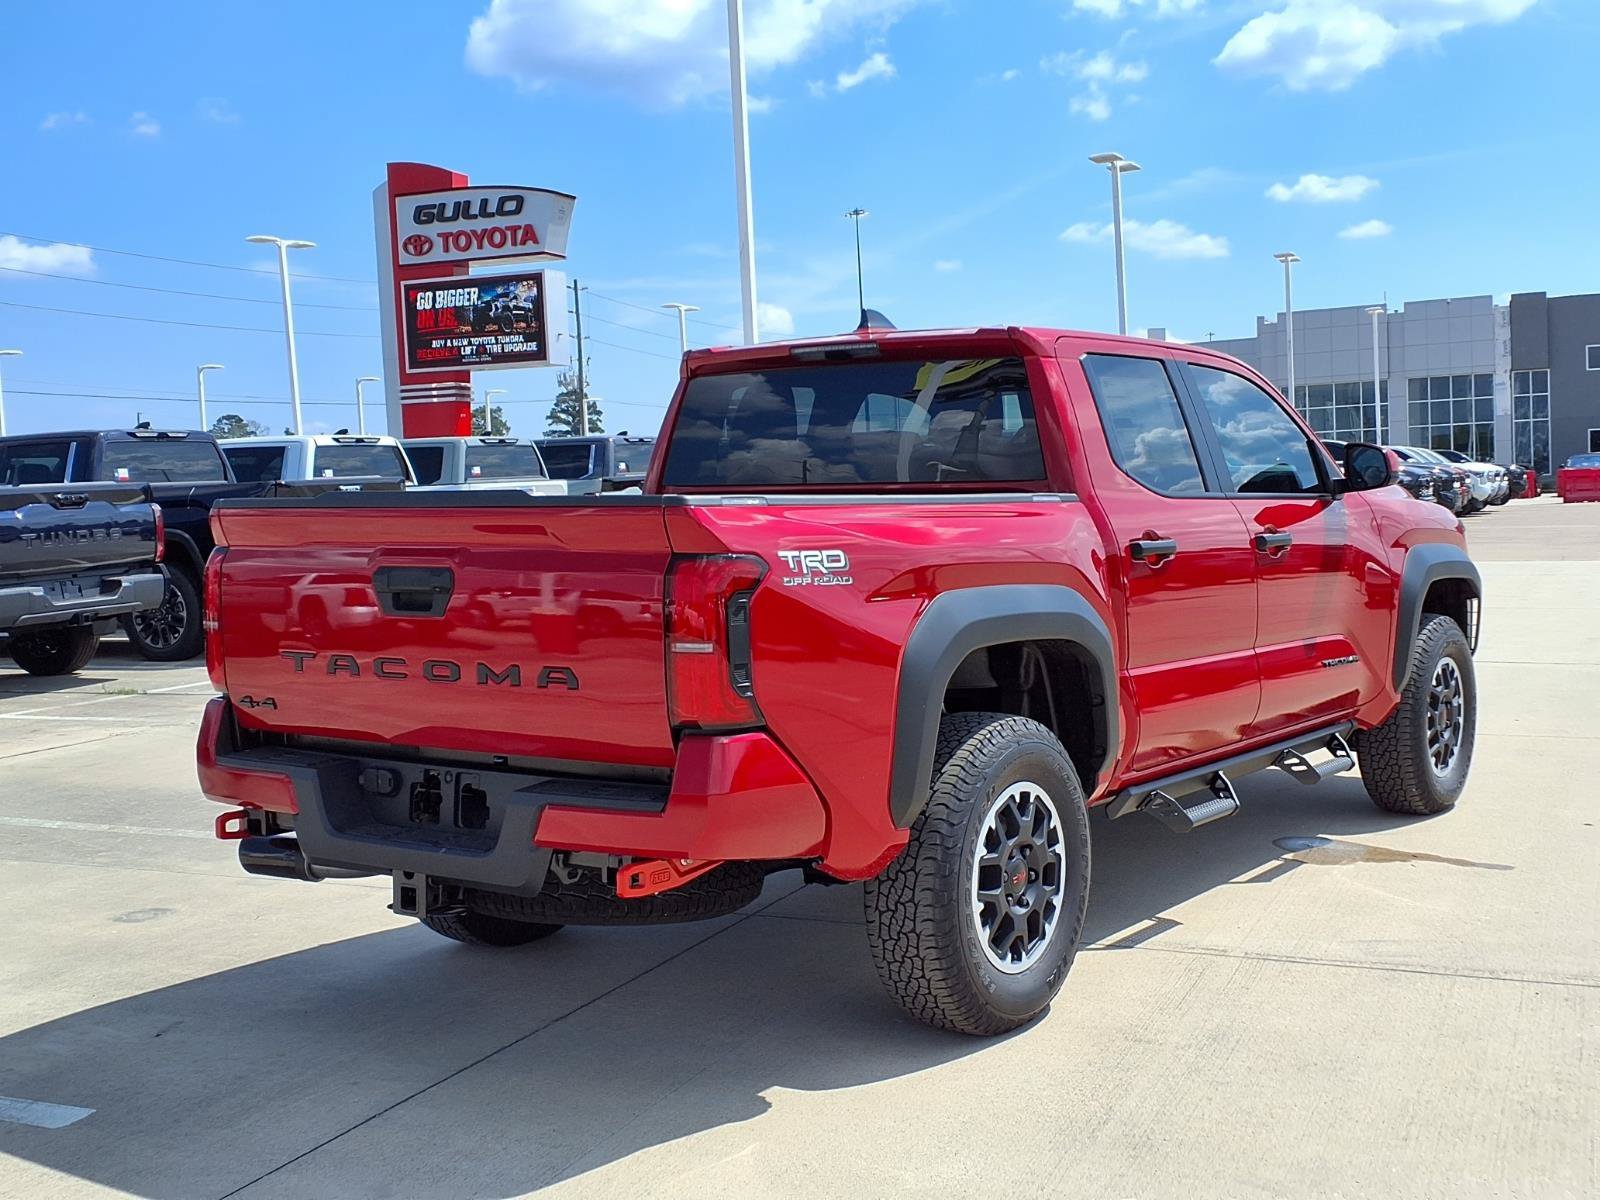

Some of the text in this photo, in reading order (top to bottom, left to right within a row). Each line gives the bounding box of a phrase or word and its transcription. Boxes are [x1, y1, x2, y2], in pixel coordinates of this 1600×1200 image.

[413, 195, 524, 225] GULLO
[437, 224, 540, 253] TOYOTA
[417, 291, 433, 310] GO
[417, 310, 435, 328] ON
[432, 340, 445, 348] BUY
[453, 338, 469, 346] NEW
[470, 337, 496, 345] TOYOTA
[497, 335, 524, 343] TUNDRA
[461, 346, 477, 355] LIFT
[485, 344, 502, 354] TIRE
[504, 342, 538, 352] UPGRADE
[20, 527, 123, 549] TUNDRA
[777, 550, 849, 576] TRD
[281, 650, 580, 691] TACOMA
